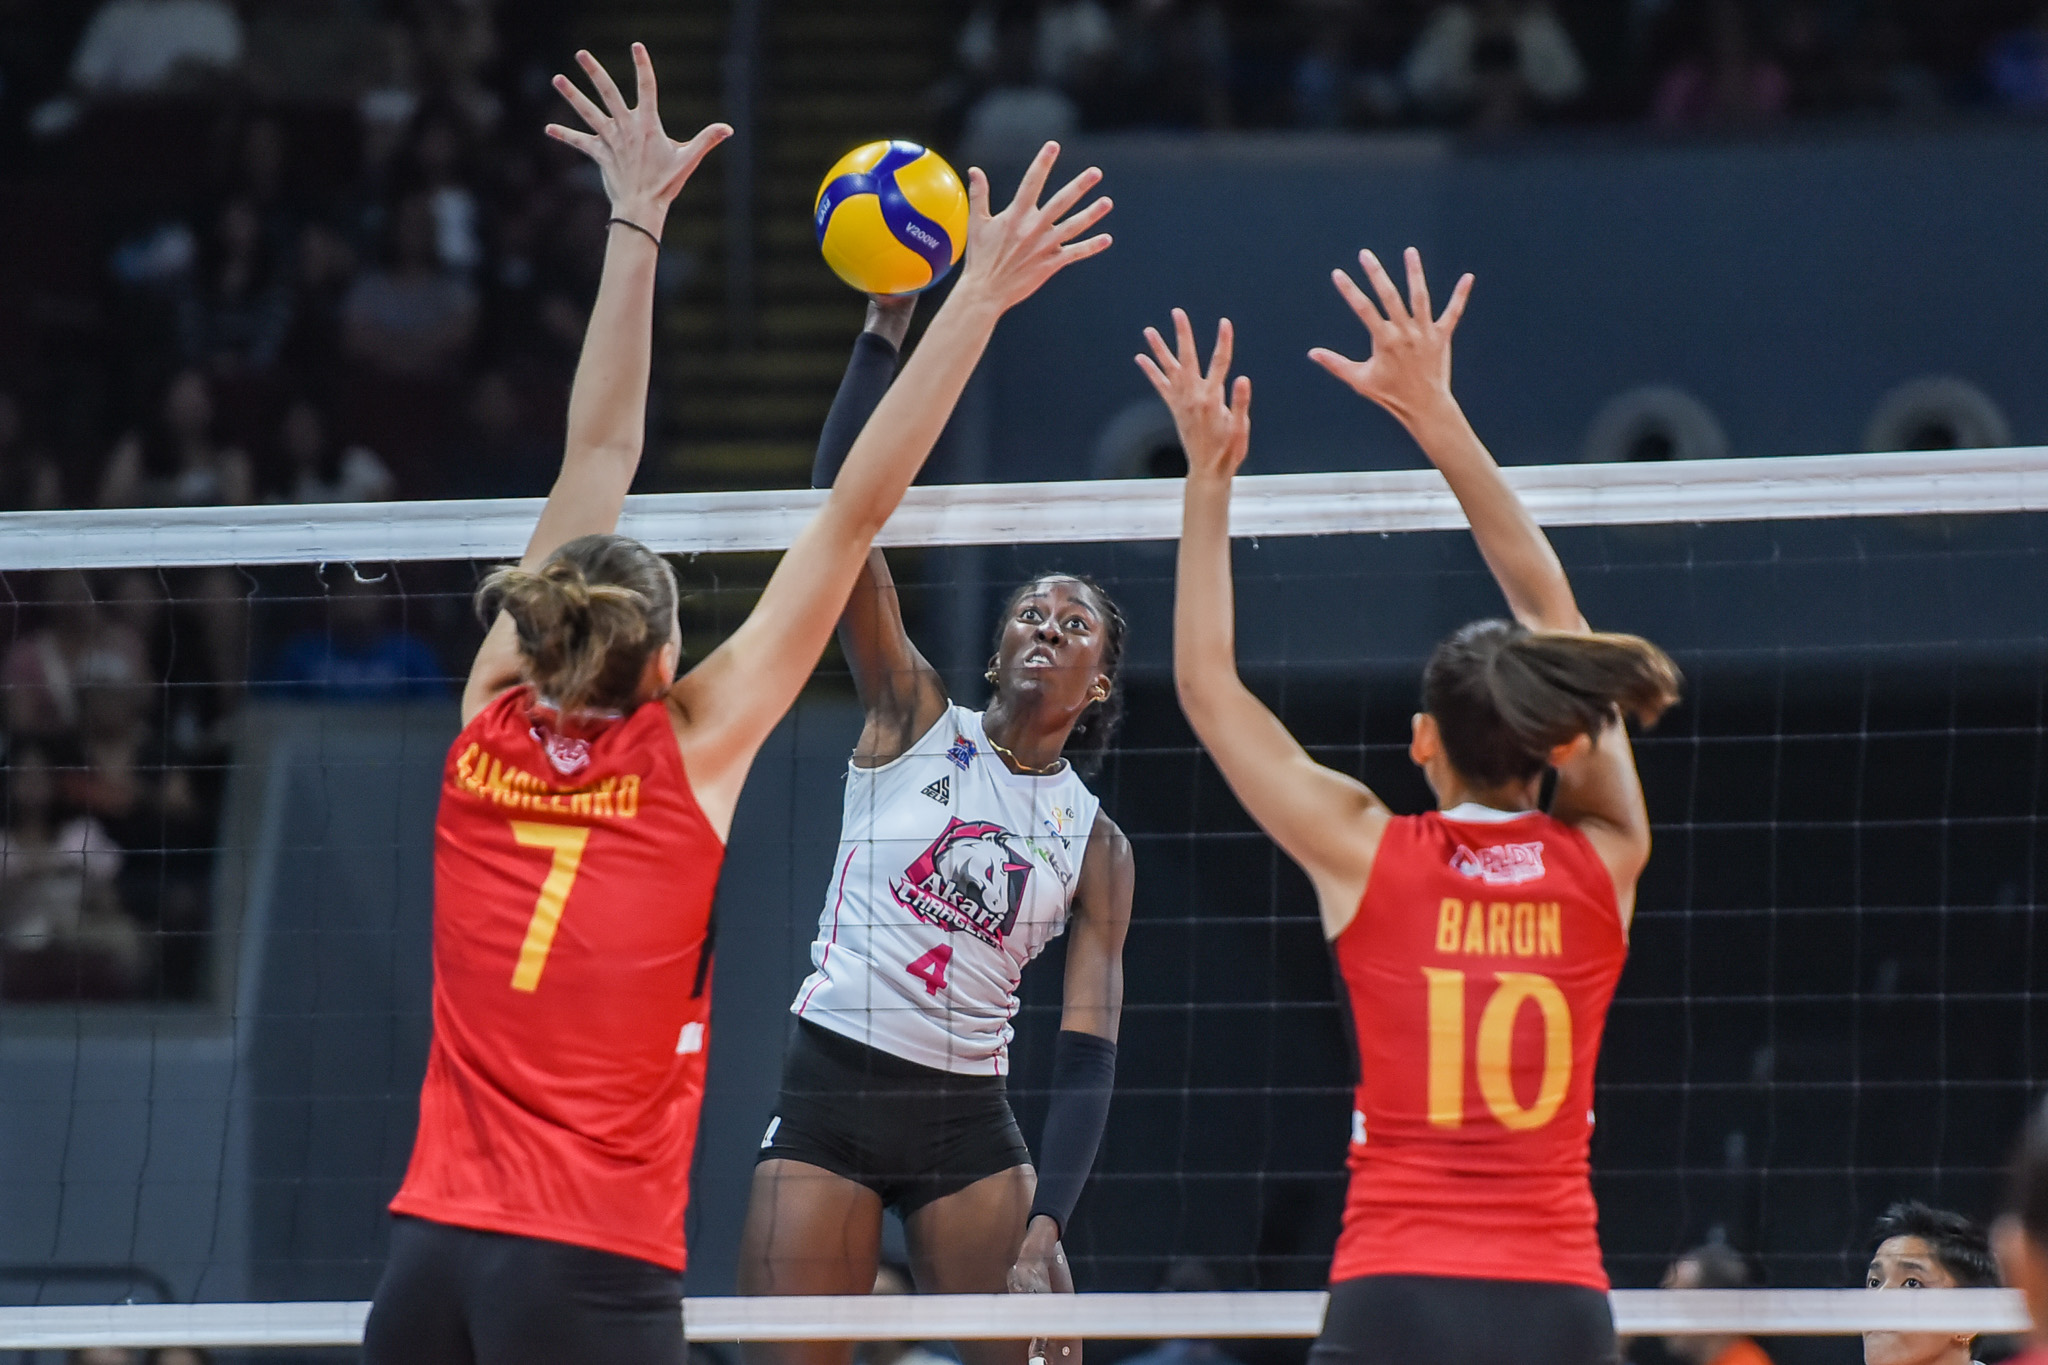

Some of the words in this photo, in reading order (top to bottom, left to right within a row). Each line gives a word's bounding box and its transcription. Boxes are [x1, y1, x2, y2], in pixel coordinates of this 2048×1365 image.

[905, 221, 940, 249] V200W
[920, 779, 949, 807] DELTA
[510, 820, 591, 994] 7
[918, 871, 1006, 934] Akari
[1435, 897, 1562, 957] BARON
[906, 943, 953, 996] 4
[1420, 965, 1573, 1131] 10
